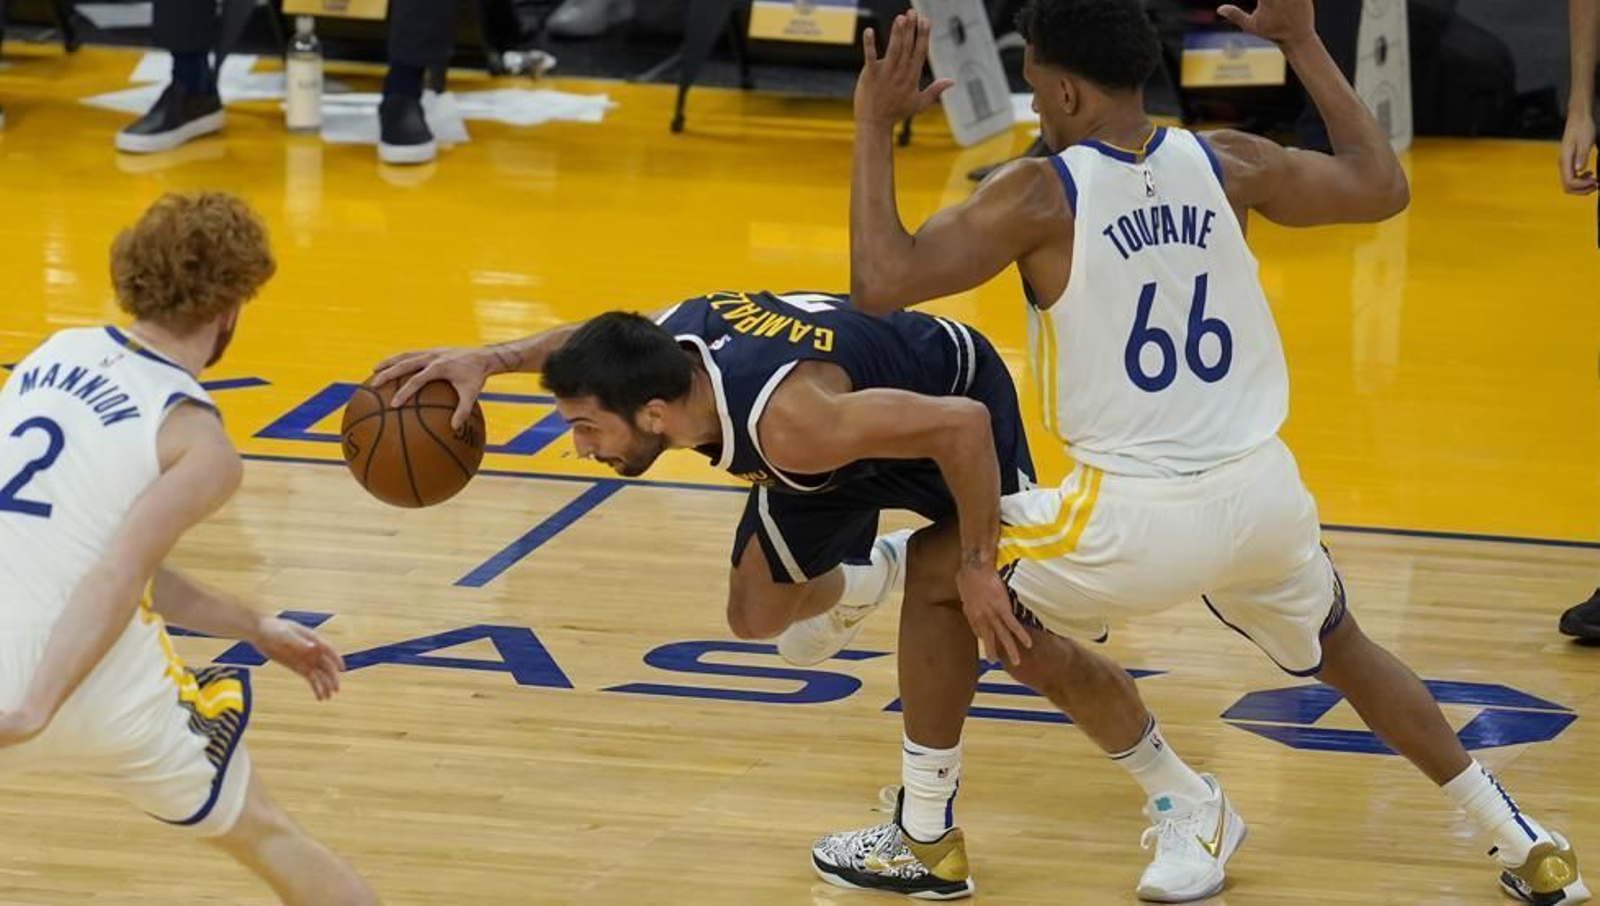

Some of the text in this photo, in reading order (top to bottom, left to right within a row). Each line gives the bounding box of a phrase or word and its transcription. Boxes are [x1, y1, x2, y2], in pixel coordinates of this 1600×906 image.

[1102, 204, 1216, 260] TOUPANE
[1124, 272, 1233, 393] 66
[19, 362, 141, 427] MANNION
[0, 416, 65, 518] 2
